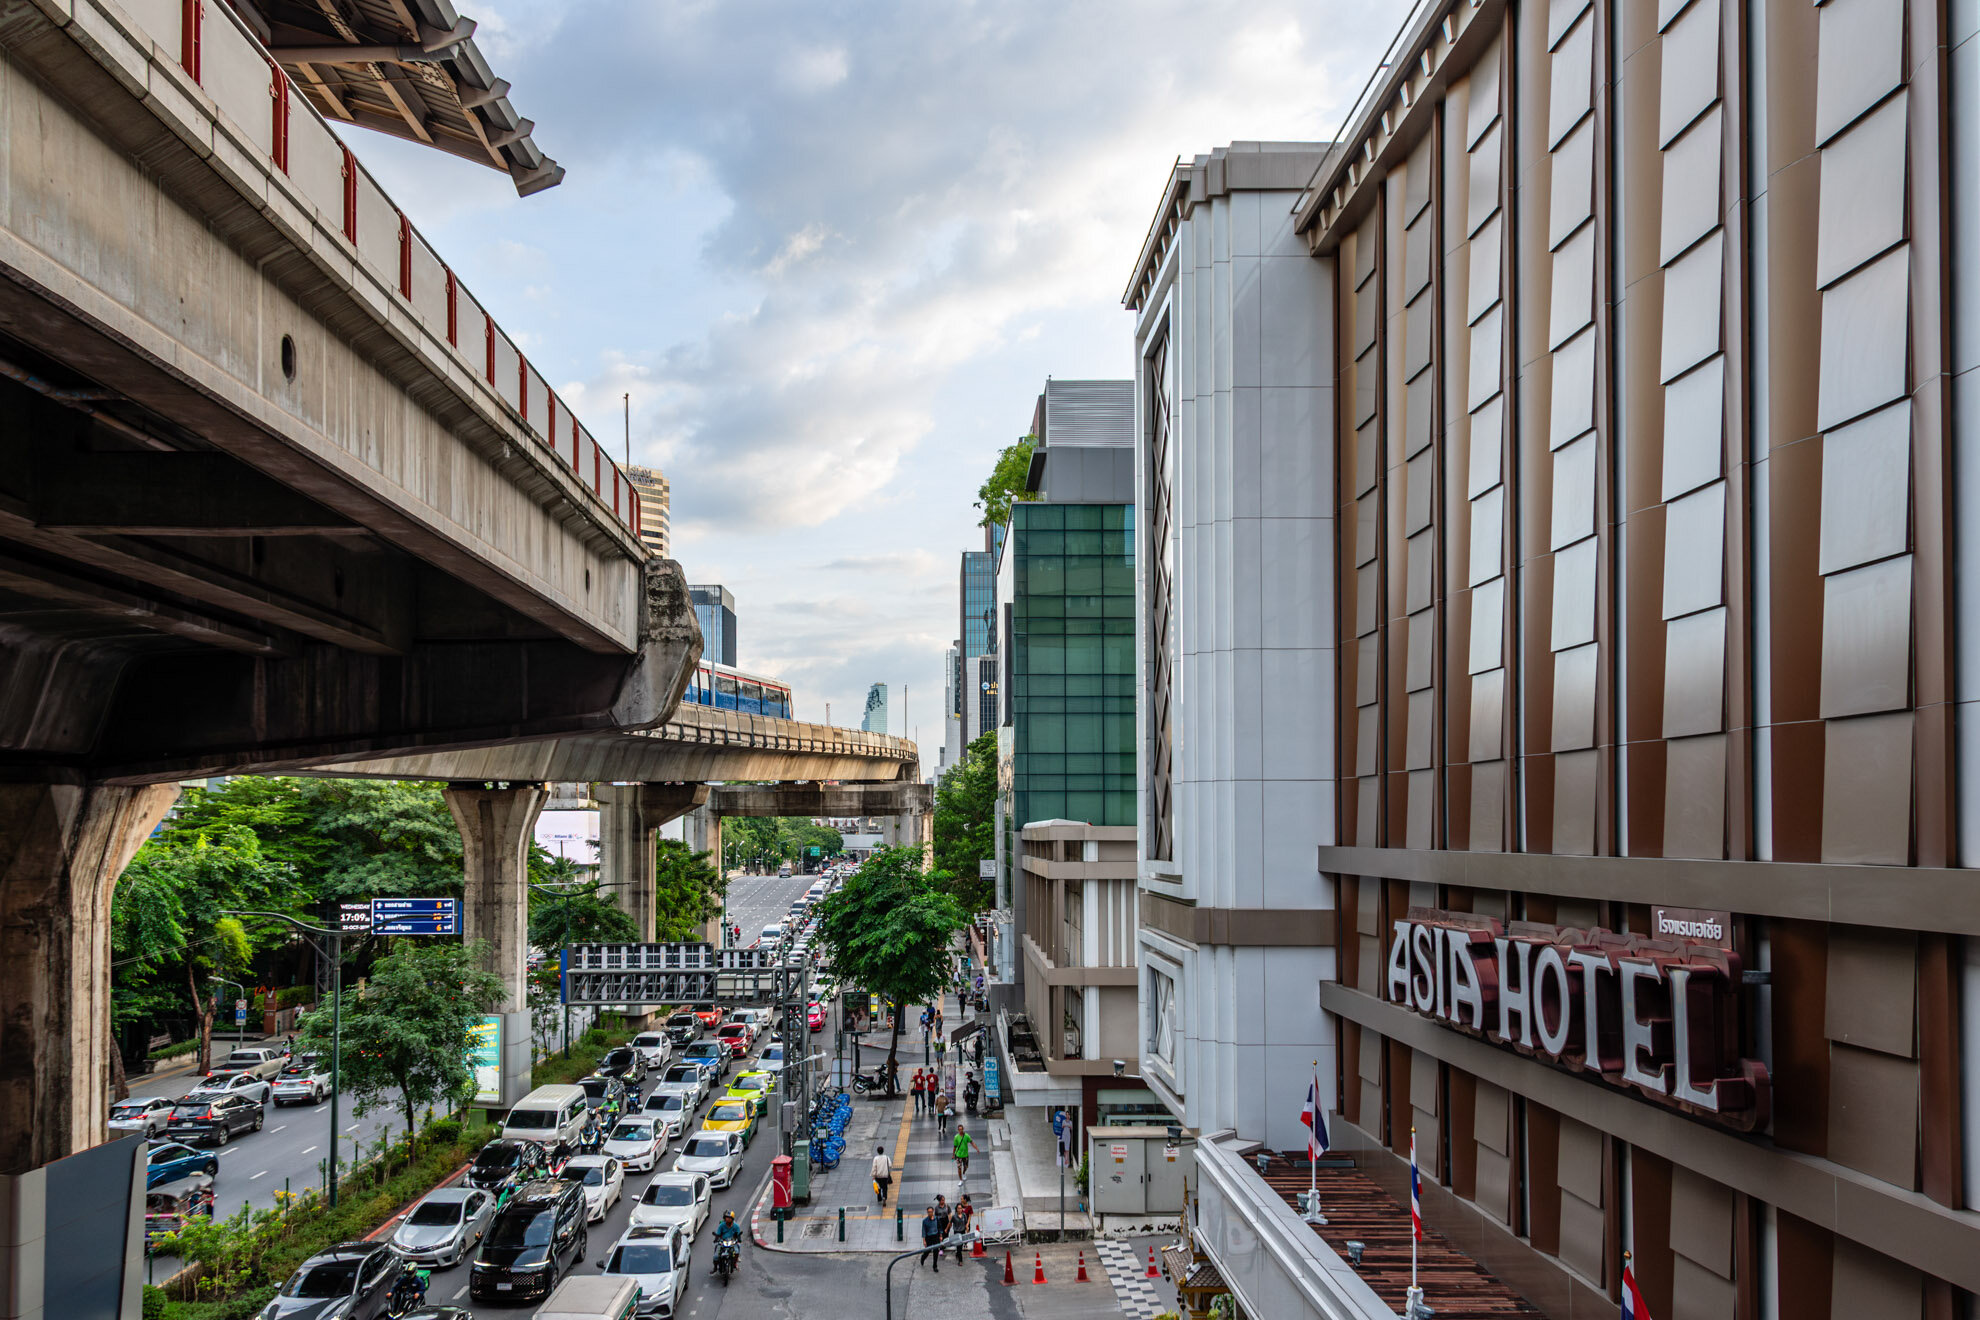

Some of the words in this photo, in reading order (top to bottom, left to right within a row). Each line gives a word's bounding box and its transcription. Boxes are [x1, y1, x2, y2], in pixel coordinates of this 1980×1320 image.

[340, 913, 366, 921] 17:09
[1388, 920, 1483, 1030] ASIA
[1494, 936, 1719, 1113] HOTEL
